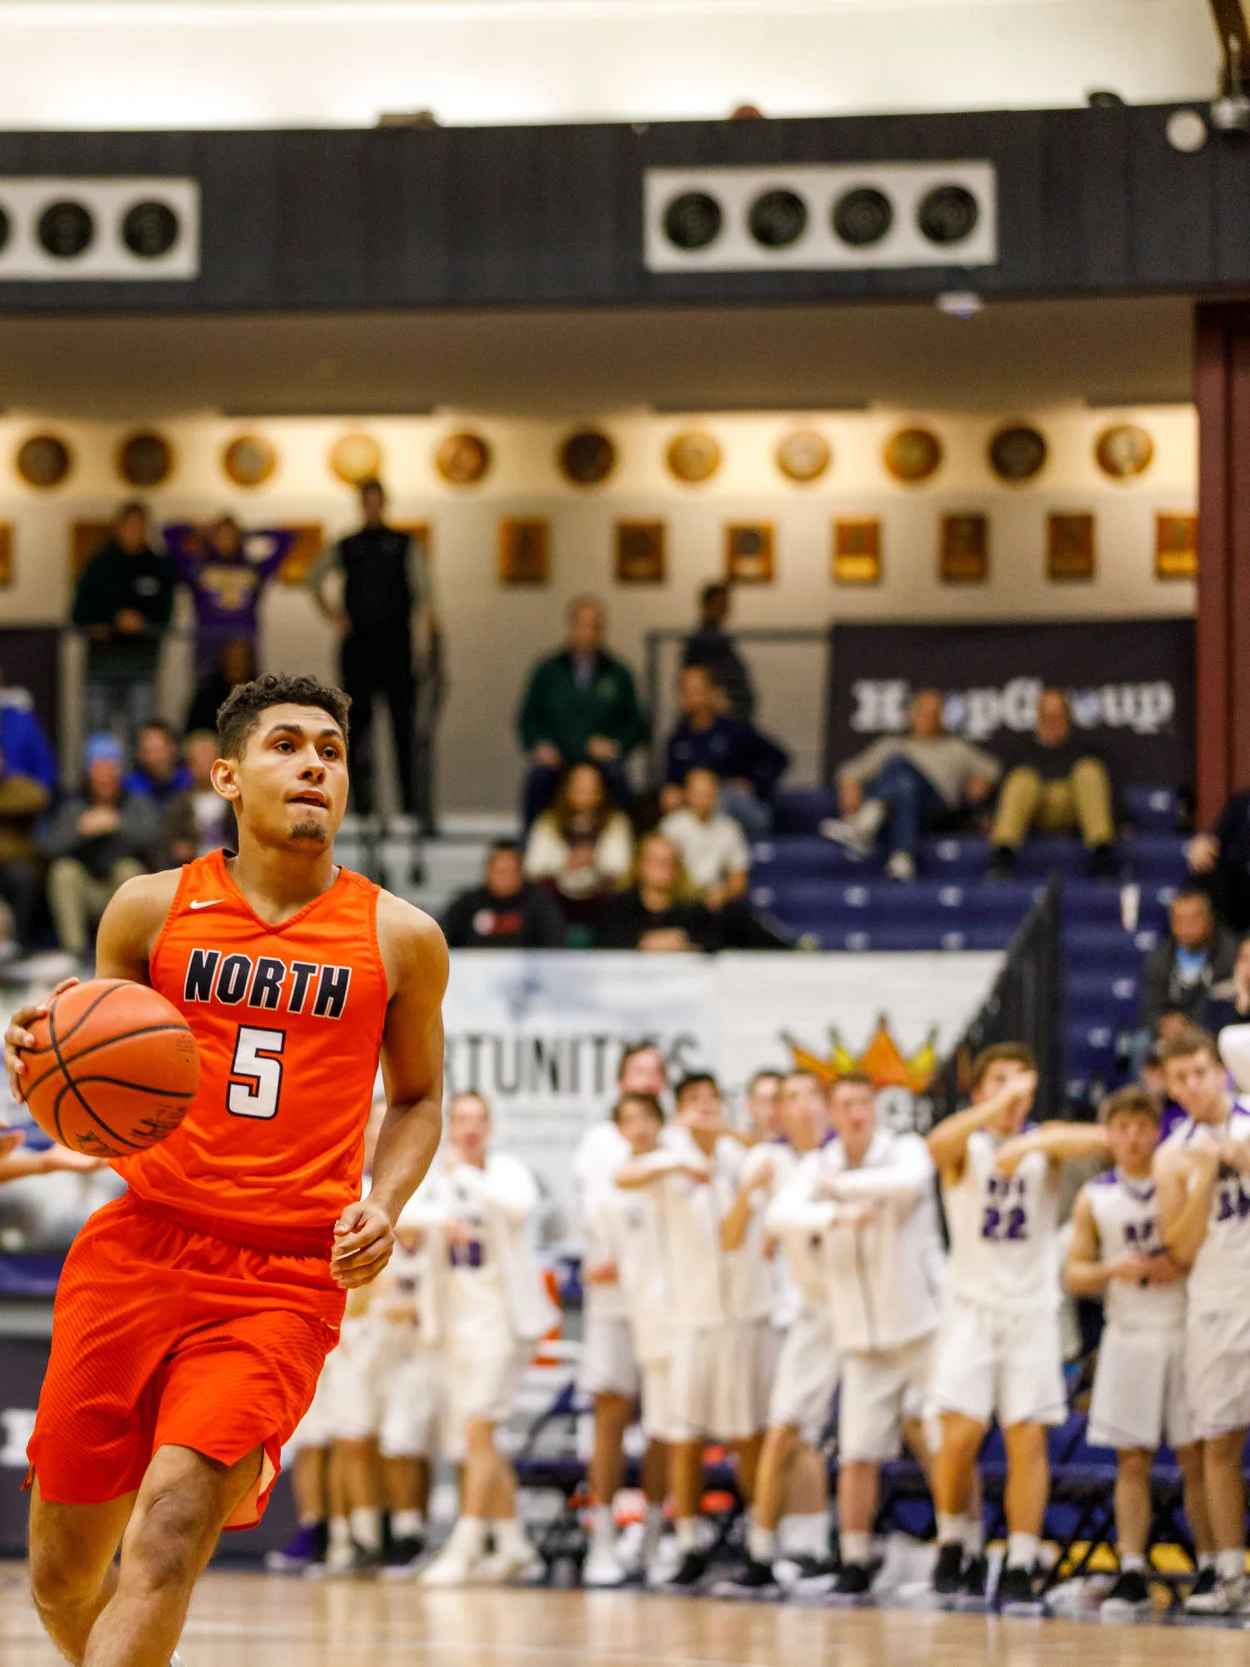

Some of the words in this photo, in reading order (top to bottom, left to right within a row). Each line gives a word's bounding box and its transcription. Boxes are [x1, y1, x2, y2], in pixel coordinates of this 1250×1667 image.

[183, 948, 352, 1020] NORTH
[226, 1023, 287, 1120] 5
[981, 1206, 1027, 1241] 22
